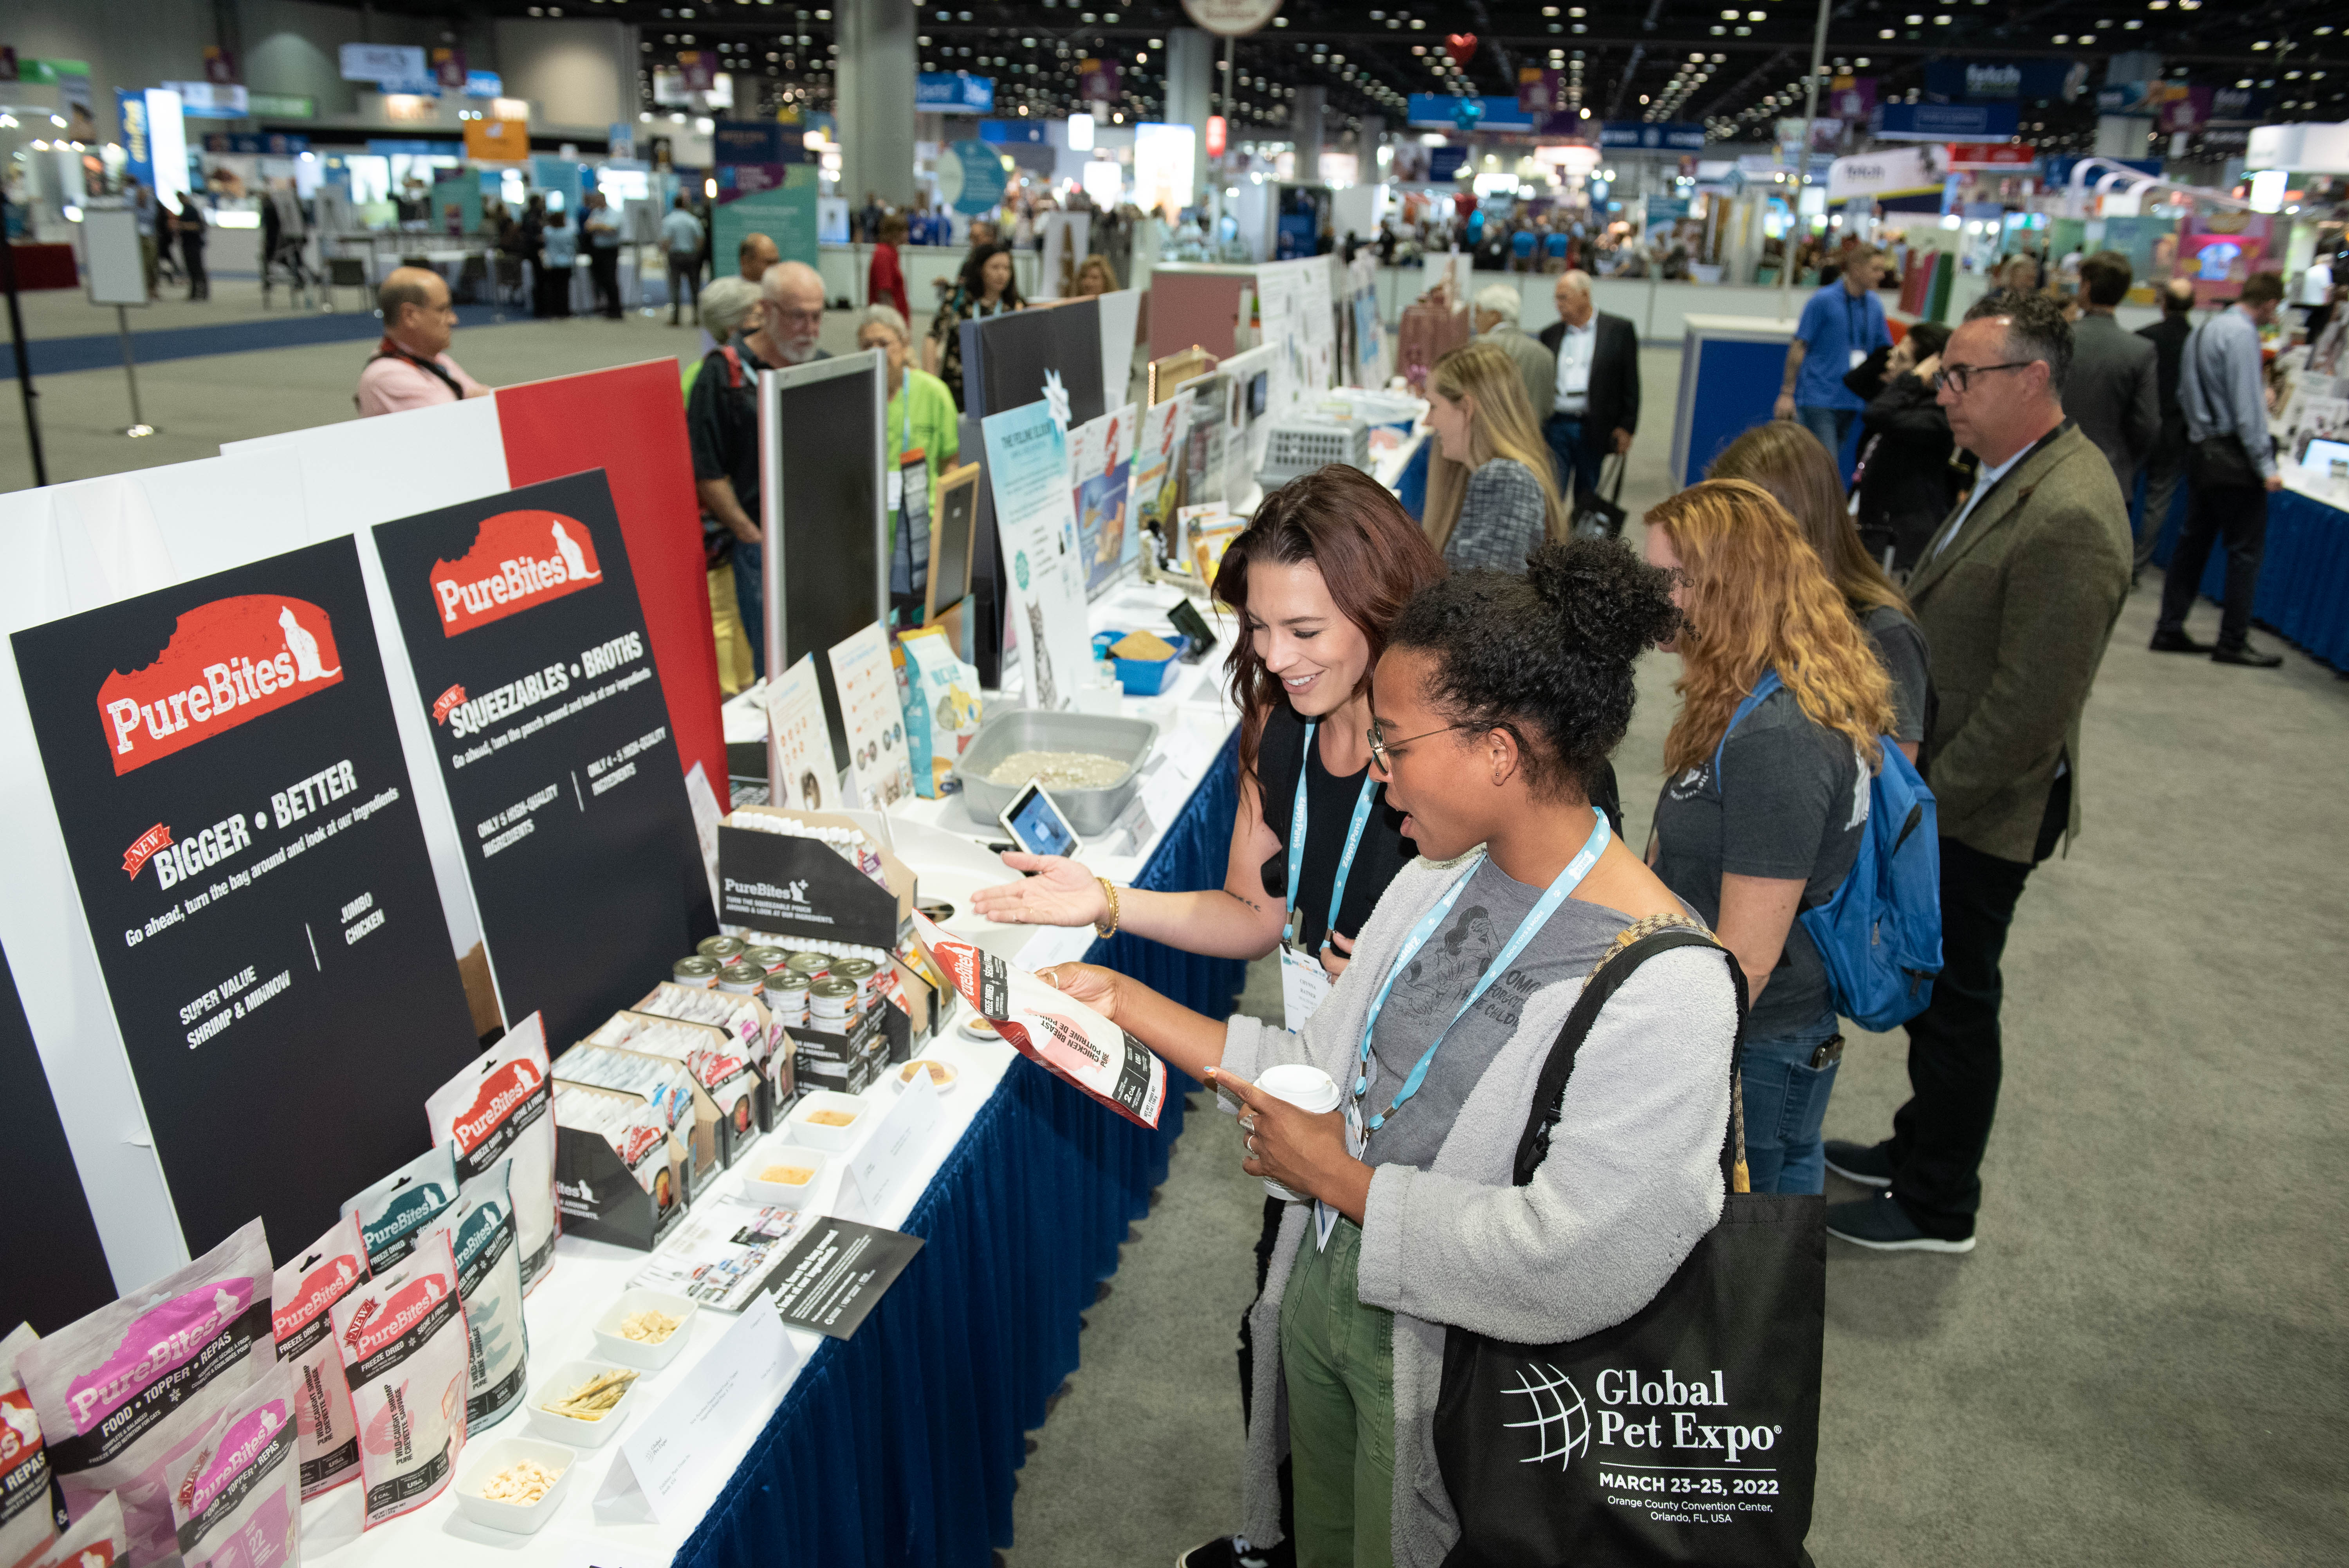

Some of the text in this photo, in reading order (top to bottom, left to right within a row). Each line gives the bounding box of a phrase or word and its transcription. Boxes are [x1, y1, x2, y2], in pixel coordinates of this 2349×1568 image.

[437, 552, 568, 623] PureBites
[106, 651, 296, 754] PureBites
[438, 690, 458, 709] NEW
[449, 631, 644, 739] SQUEEZABLES BROTHS
[452, 667, 652, 769] Go ahead, turn the pouch around and look at our ingredients
[587, 726, 666, 778] ONLY 4 5 HIGH-QUALITY
[592, 761, 637, 797] INGREDIENTS
[153, 759, 358, 891] BIGGER BETTER
[477, 783, 558, 839] ONLY 5 HIGH-QUALITY
[1293, 796, 1306, 849] ZippyPaws
[130, 830, 159, 862] NEW
[482, 818, 536, 859] INGREDIENTS
[1342, 816, 1363, 869] ZippyPaws
[125, 787, 400, 947] Go ahead, turn the bag around and look at our ingredients
[340, 891, 374, 924] JUMBO
[724, 877, 791, 900] PureBites
[345, 908, 385, 945] CHICKEN
[1506, 944, 1517, 958] DOG
[1515, 929, 1528, 947] TOYS
[1530, 909, 1545, 927] MORE
[179, 965, 257, 1025] SUPER VALUE
[954, 954, 974, 999] ureBites
[1487, 983, 1524, 1008] FORGOT
[187, 970, 291, 1050] SHRIMP & MINNOW
[985, 983, 994, 1016] FREEZE DRIED
[1040, 1020, 1099, 1063] CHICKEN BREAST
[1059, 1022, 1101, 1056] POITRINE DE
[1100, 1052, 1109, 1068] PURE
[456, 1083, 523, 1147] PureBites
[1124, 1093, 1132, 1103] 2
[469, 1143, 489, 1166] FREEZE
[363, 1202, 429, 1251] PureBites
[498, 1226, 509, 1241] FROID
[370, 1250, 389, 1266] FREEZE
[388, 1240, 406, 1254] DRIED
[465, 1264, 478, 1280] DRIED
[273, 1276, 344, 1337] PureBites
[349, 1306, 369, 1336] NEW
[359, 1295, 430, 1356] PureBites
[279, 1333, 303, 1354] FREEZE
[303, 1321, 321, 1338] DRIED
[361, 1354, 385, 1372] FREEZE
[385, 1341, 405, 1357] DRIED
[434, 1302, 449, 1319] FROID
[472, 1326, 488, 1390] PURE SAUVAGE
[72, 1315, 218, 1424] PureBites
[101, 1331, 232, 1438] FOOD TOPPER REPAS
[303, 1365, 316, 1394] SHRIMP
[1596, 1369, 1728, 1406] Global
[309, 1394, 324, 1439] WILD-CAUGHT
[312, 1366, 334, 1446] PURE CREVETTE SAUVAGE
[384, 1384, 403, 1459] WILD-CAUGHT SHRIMP
[395, 1387, 413, 1466] PURE CREVETTE SAUVAGE
[650, 1436, 662, 1451] Global
[1597, 1410, 1662, 1448] Pet
[5, 1451, 46, 1491] REPAS
[184, 1460, 202, 1494] NEW
[192, 1427, 269, 1513] PureBites
[203, 1498, 220, 1521] FOOD
[227, 1467, 254, 1496] TOPPER
[258, 1440, 280, 1466] REPAS
[407, 1478, 423, 1489] USA
[1600, 1472, 1665, 1492] MARCH
[1733, 1480, 1779, 1495] 2022
[1607, 1495, 1773, 1513] Orange County Convention Center,
[1651, 1511, 1732, 1524] Orlando, FL, USA
[249, 1528, 267, 1556] 22
